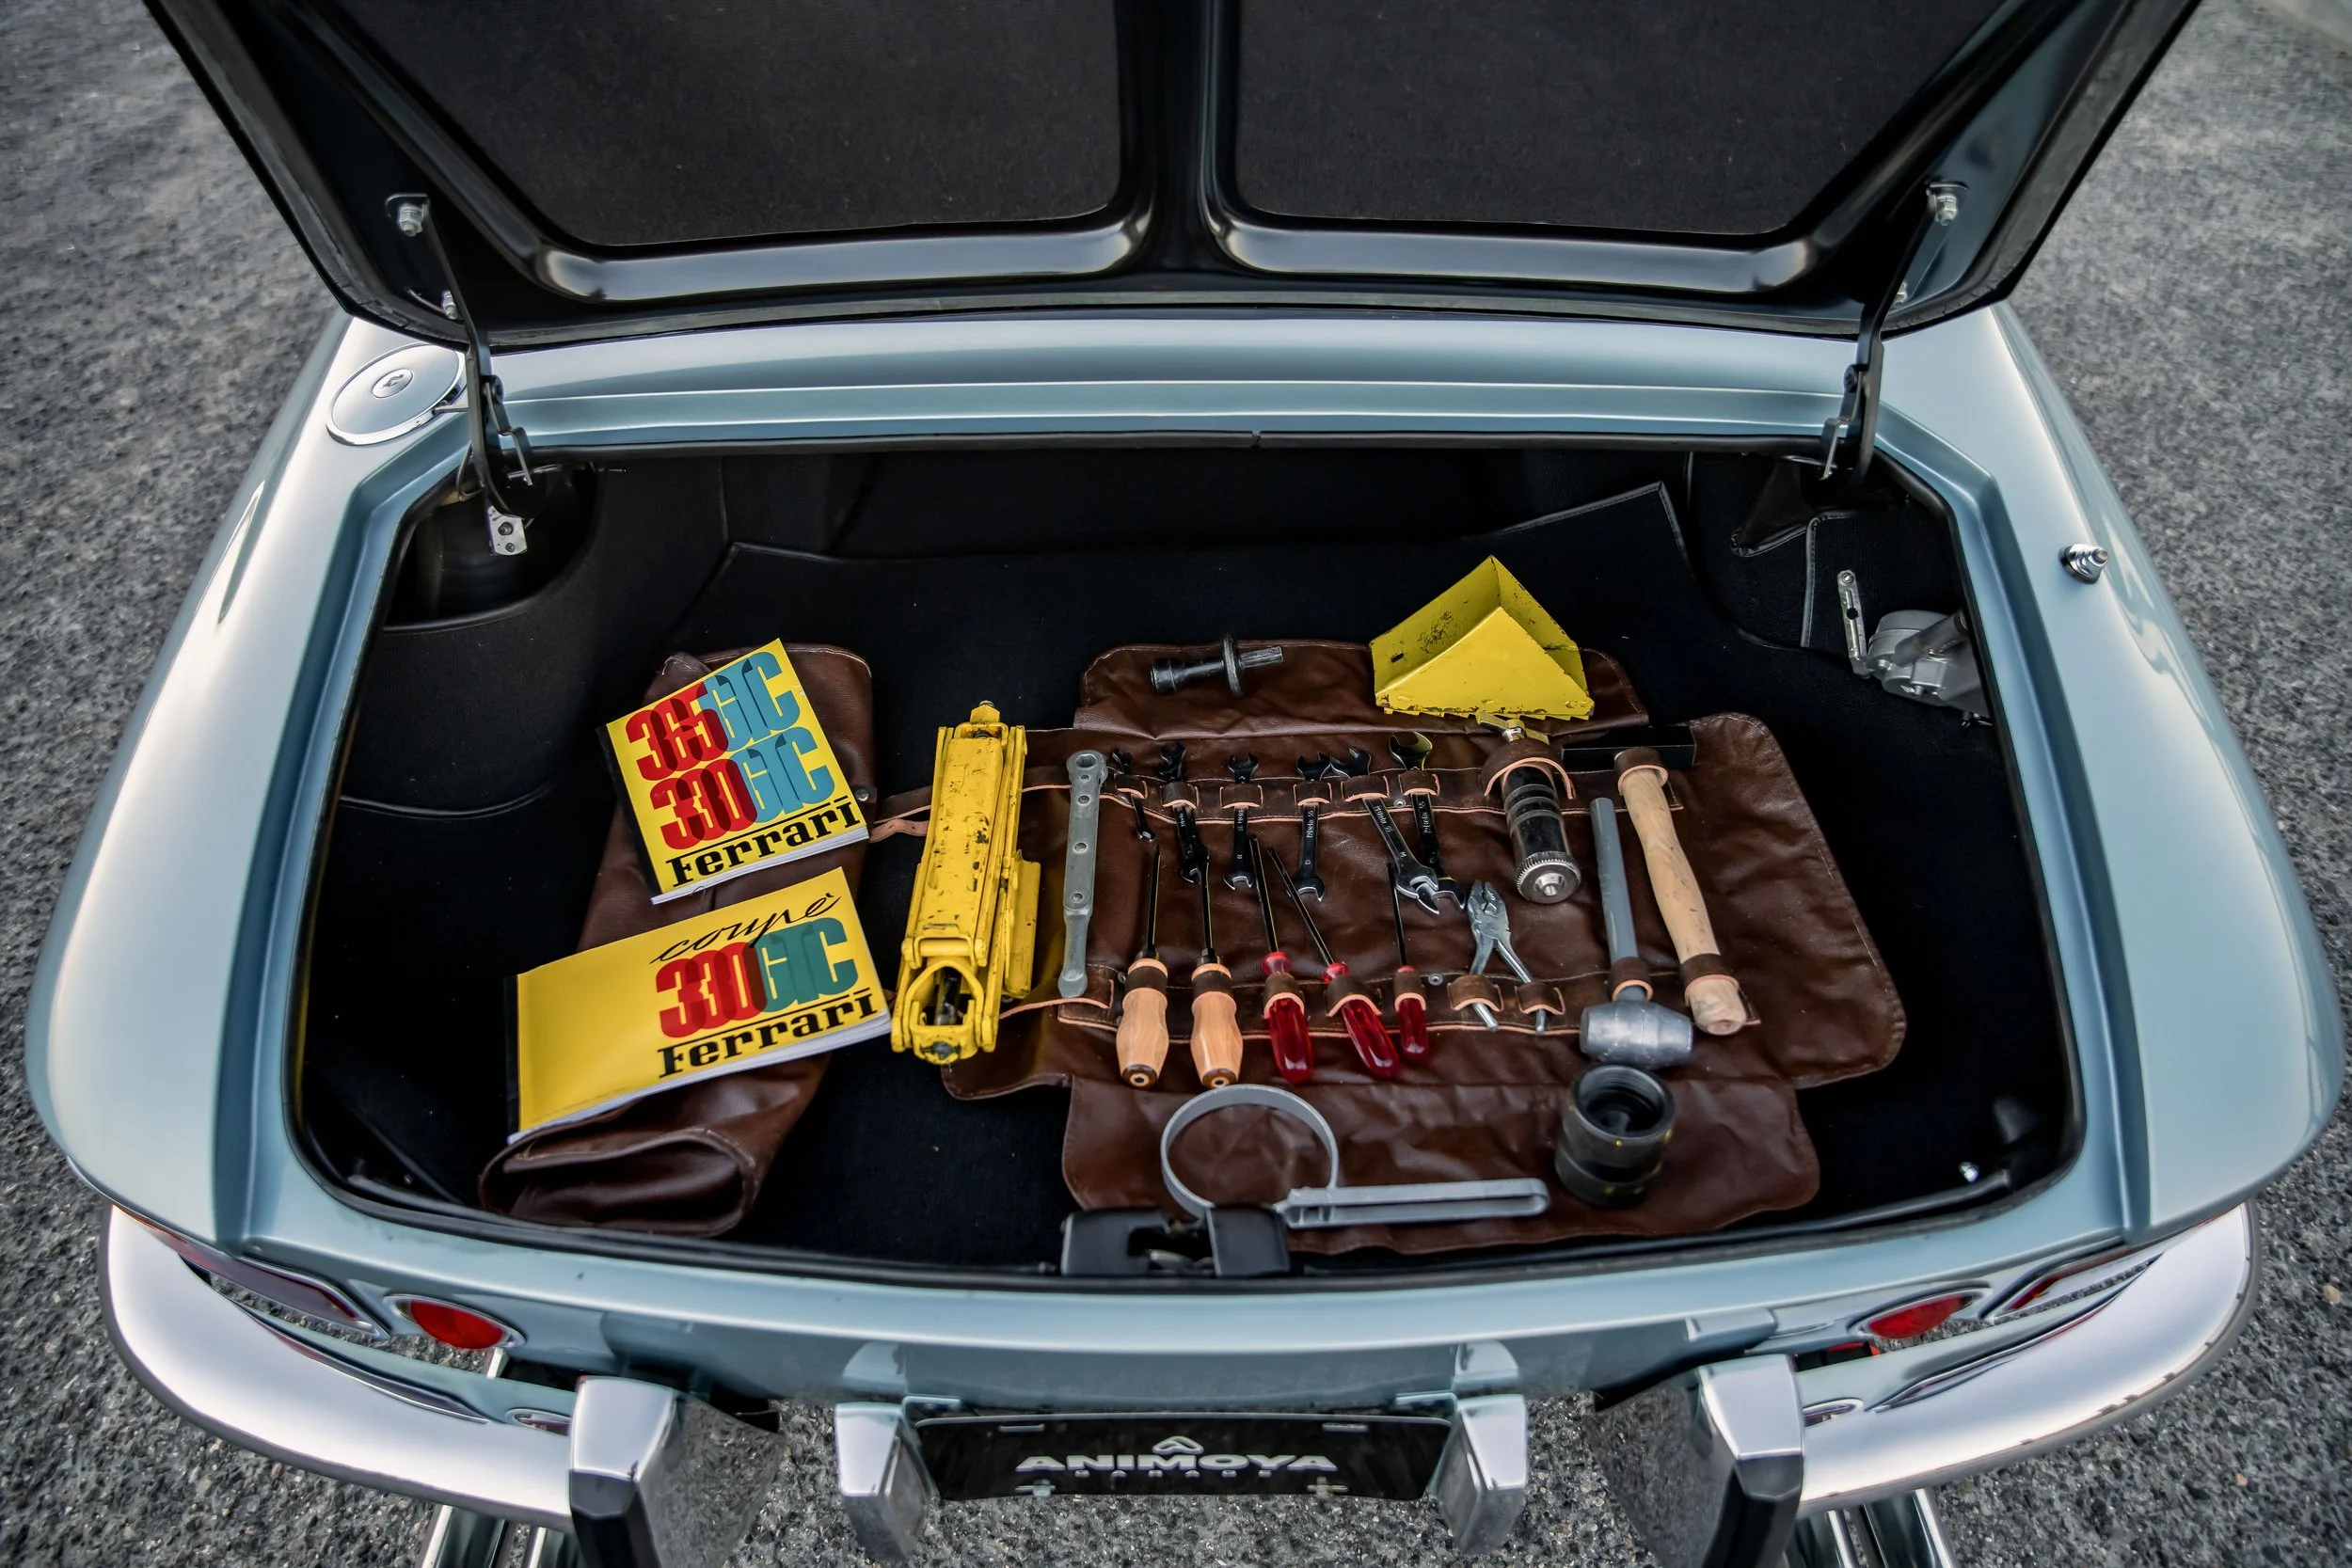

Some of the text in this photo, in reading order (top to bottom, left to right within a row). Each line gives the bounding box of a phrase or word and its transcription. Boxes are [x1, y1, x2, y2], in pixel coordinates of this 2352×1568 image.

[666, 796, 861, 886] Ferrari
[658, 989, 878, 1078] Ferrari
[1015, 1455, 1338, 1472] ANIMOYA
